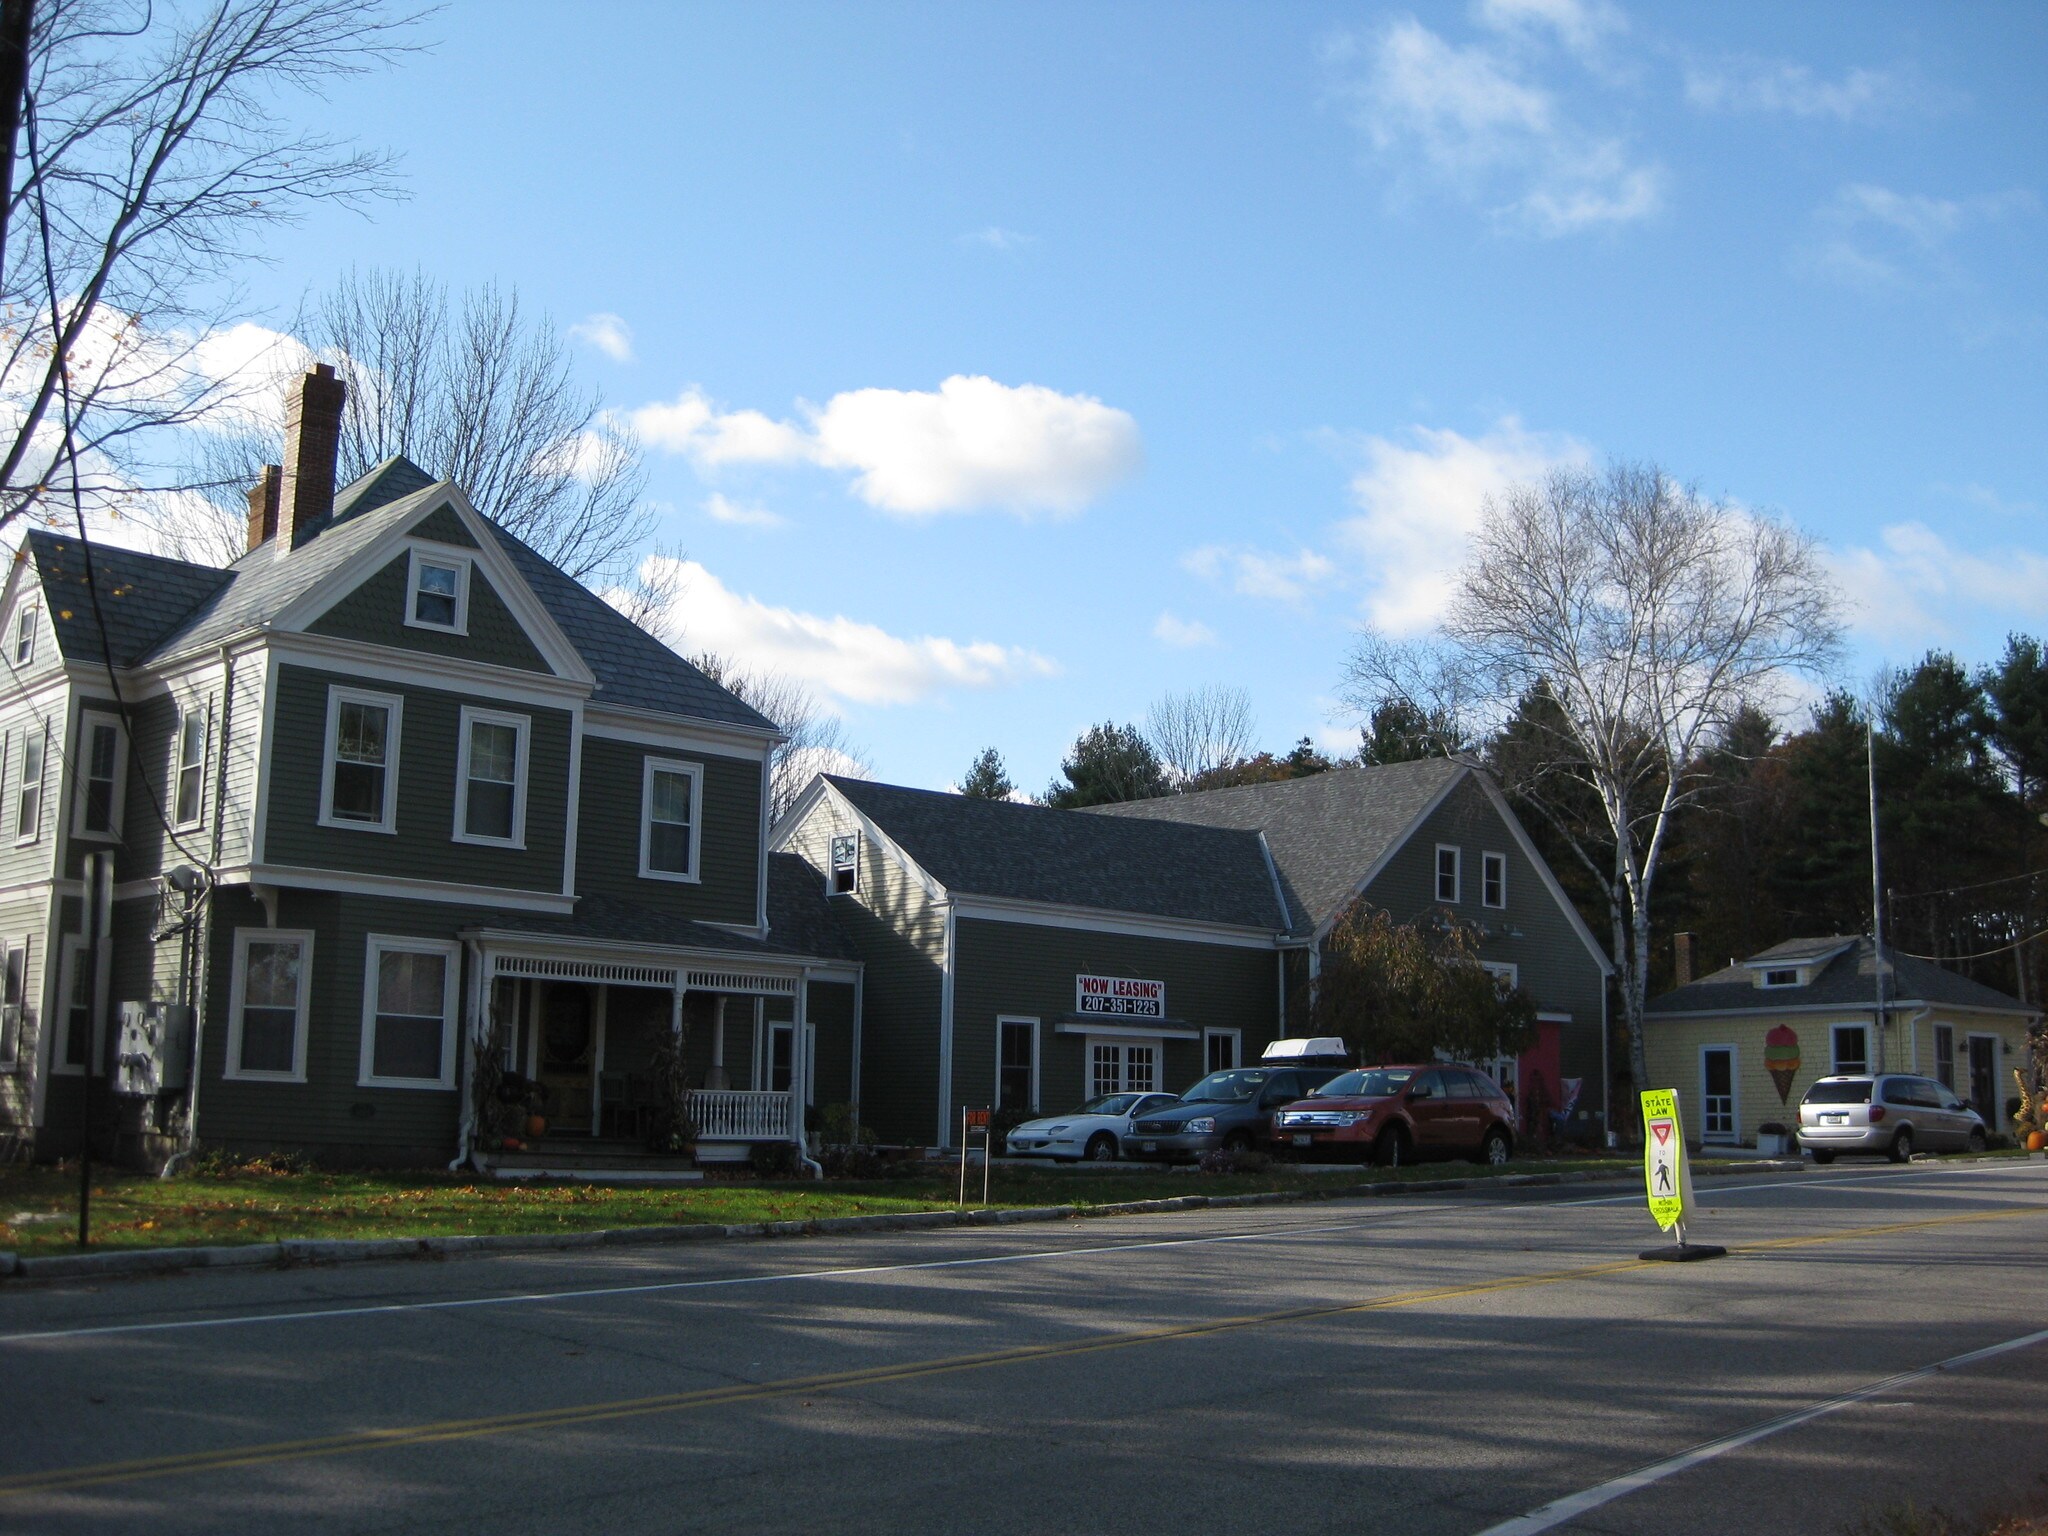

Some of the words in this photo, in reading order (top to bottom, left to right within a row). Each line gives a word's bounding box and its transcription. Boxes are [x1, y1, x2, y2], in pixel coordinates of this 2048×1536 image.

[1085, 997, 1156, 1015] 207-351-1225
[1645, 1098, 1671, 1107] STATE
[1651, 1108, 1668, 1116] LAW
